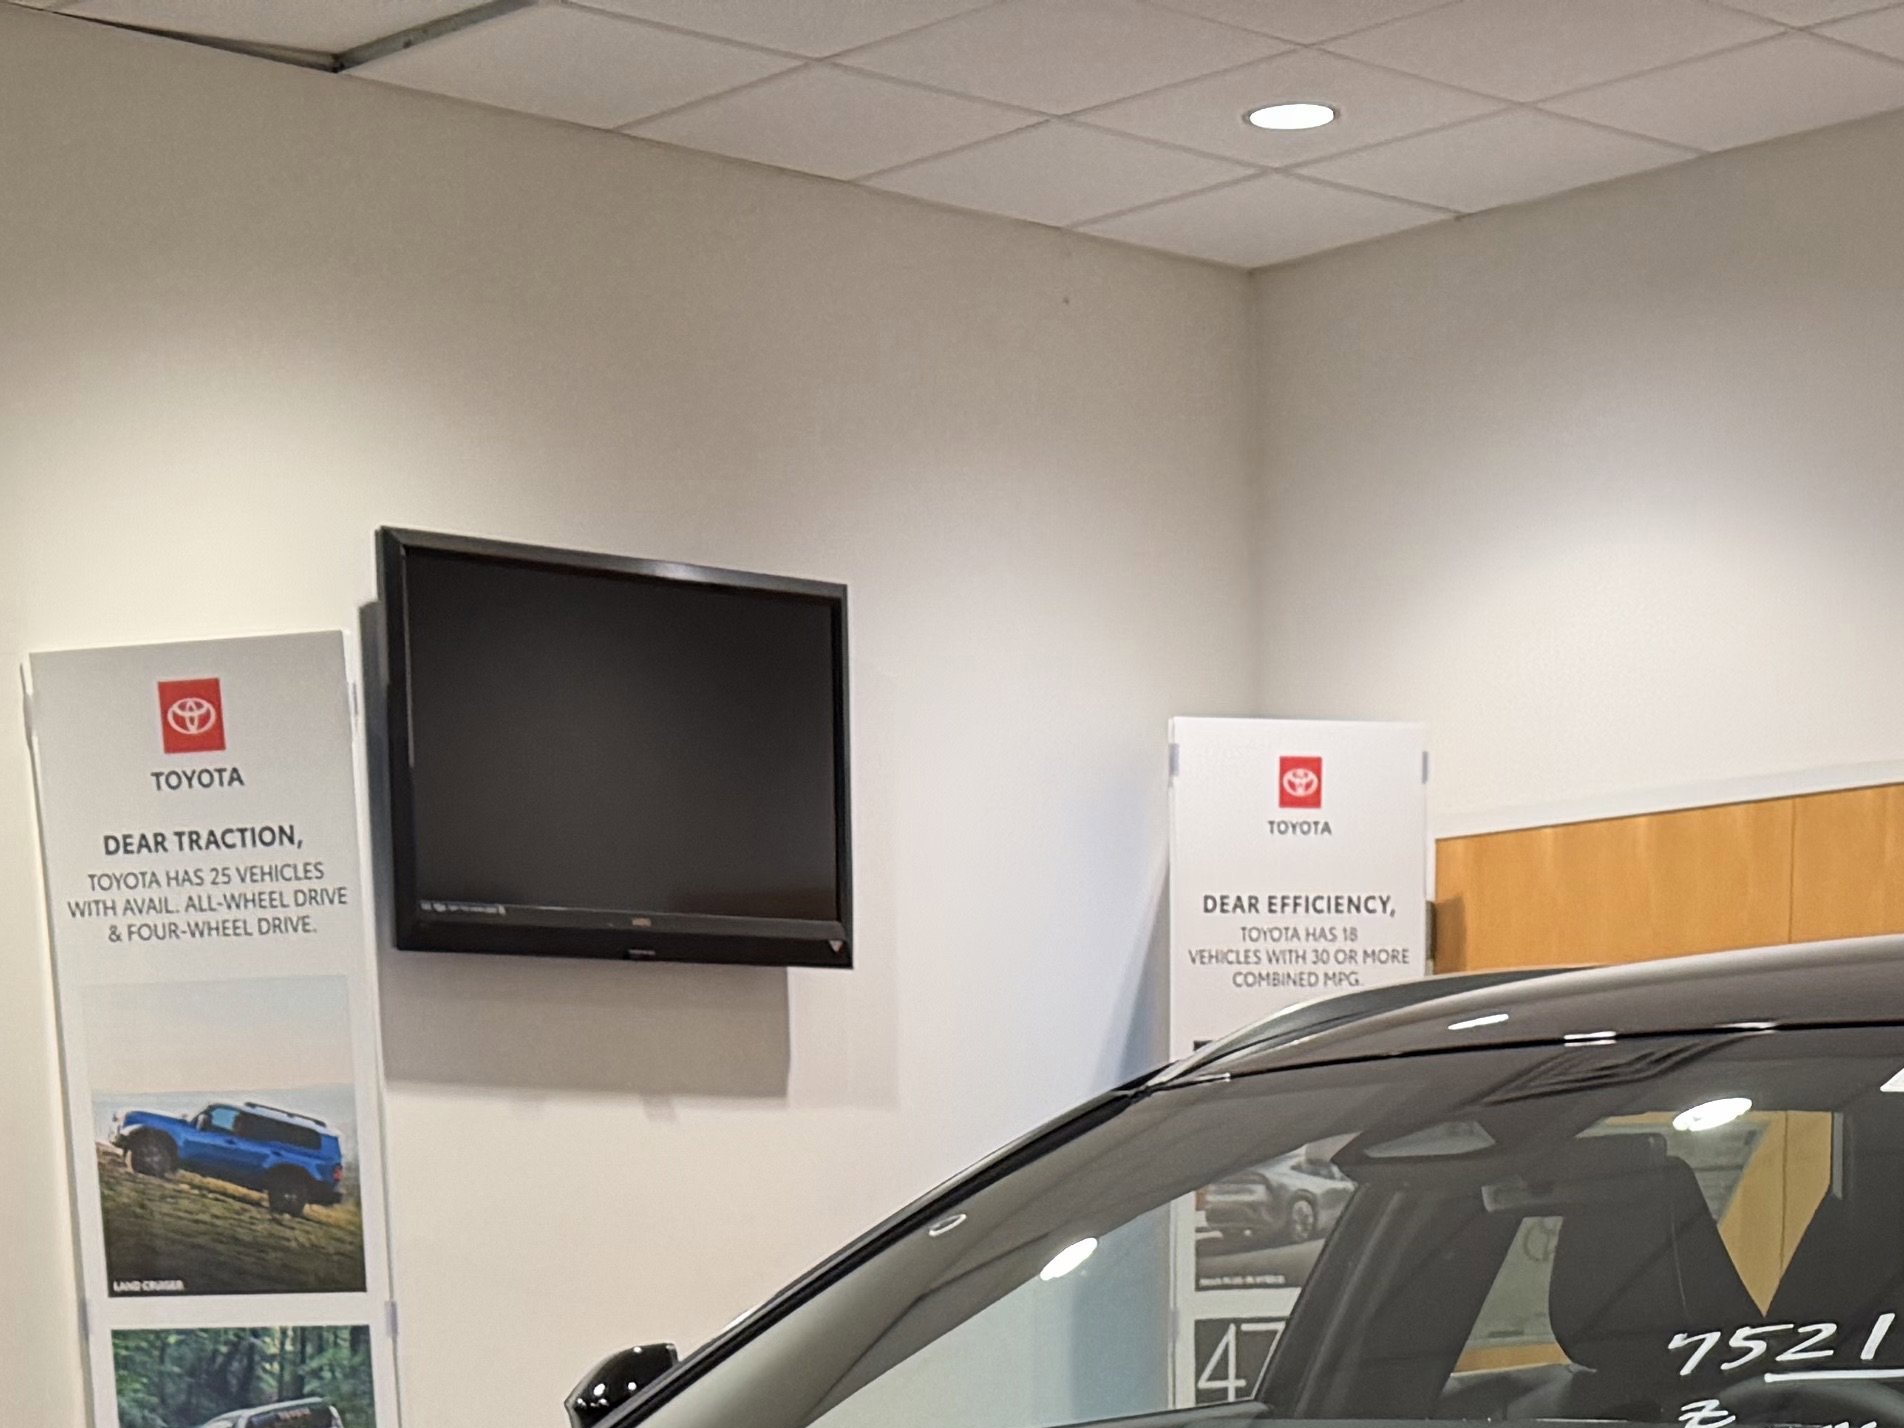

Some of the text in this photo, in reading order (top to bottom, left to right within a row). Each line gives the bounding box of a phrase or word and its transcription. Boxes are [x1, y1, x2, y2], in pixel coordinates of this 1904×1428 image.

[150, 766, 245, 791] TOYOTA
[103, 824, 303, 856] DEAR TRACTION,
[1267, 820, 1332, 836] TOYOTA
[88, 861, 325, 892] TOYOTA HAS 25 VEHICLES
[67, 886, 348, 919] WITH AVAIL. ALL-WHEEL DRIVE
[1202, 894, 1396, 917] DEAR EFFICIENCY,
[108, 915, 317, 943] & FOUR-WHEEL DRIVE.
[1240, 926, 1301, 942] TOYOTA
[1305, 926, 1338, 942] HAS
[1188, 949, 1410, 965] VEHICLES WITH 30 OR MORE
[1232, 971, 1319, 988] COMBINED
[1668, 1313, 1896, 1375] 7521
